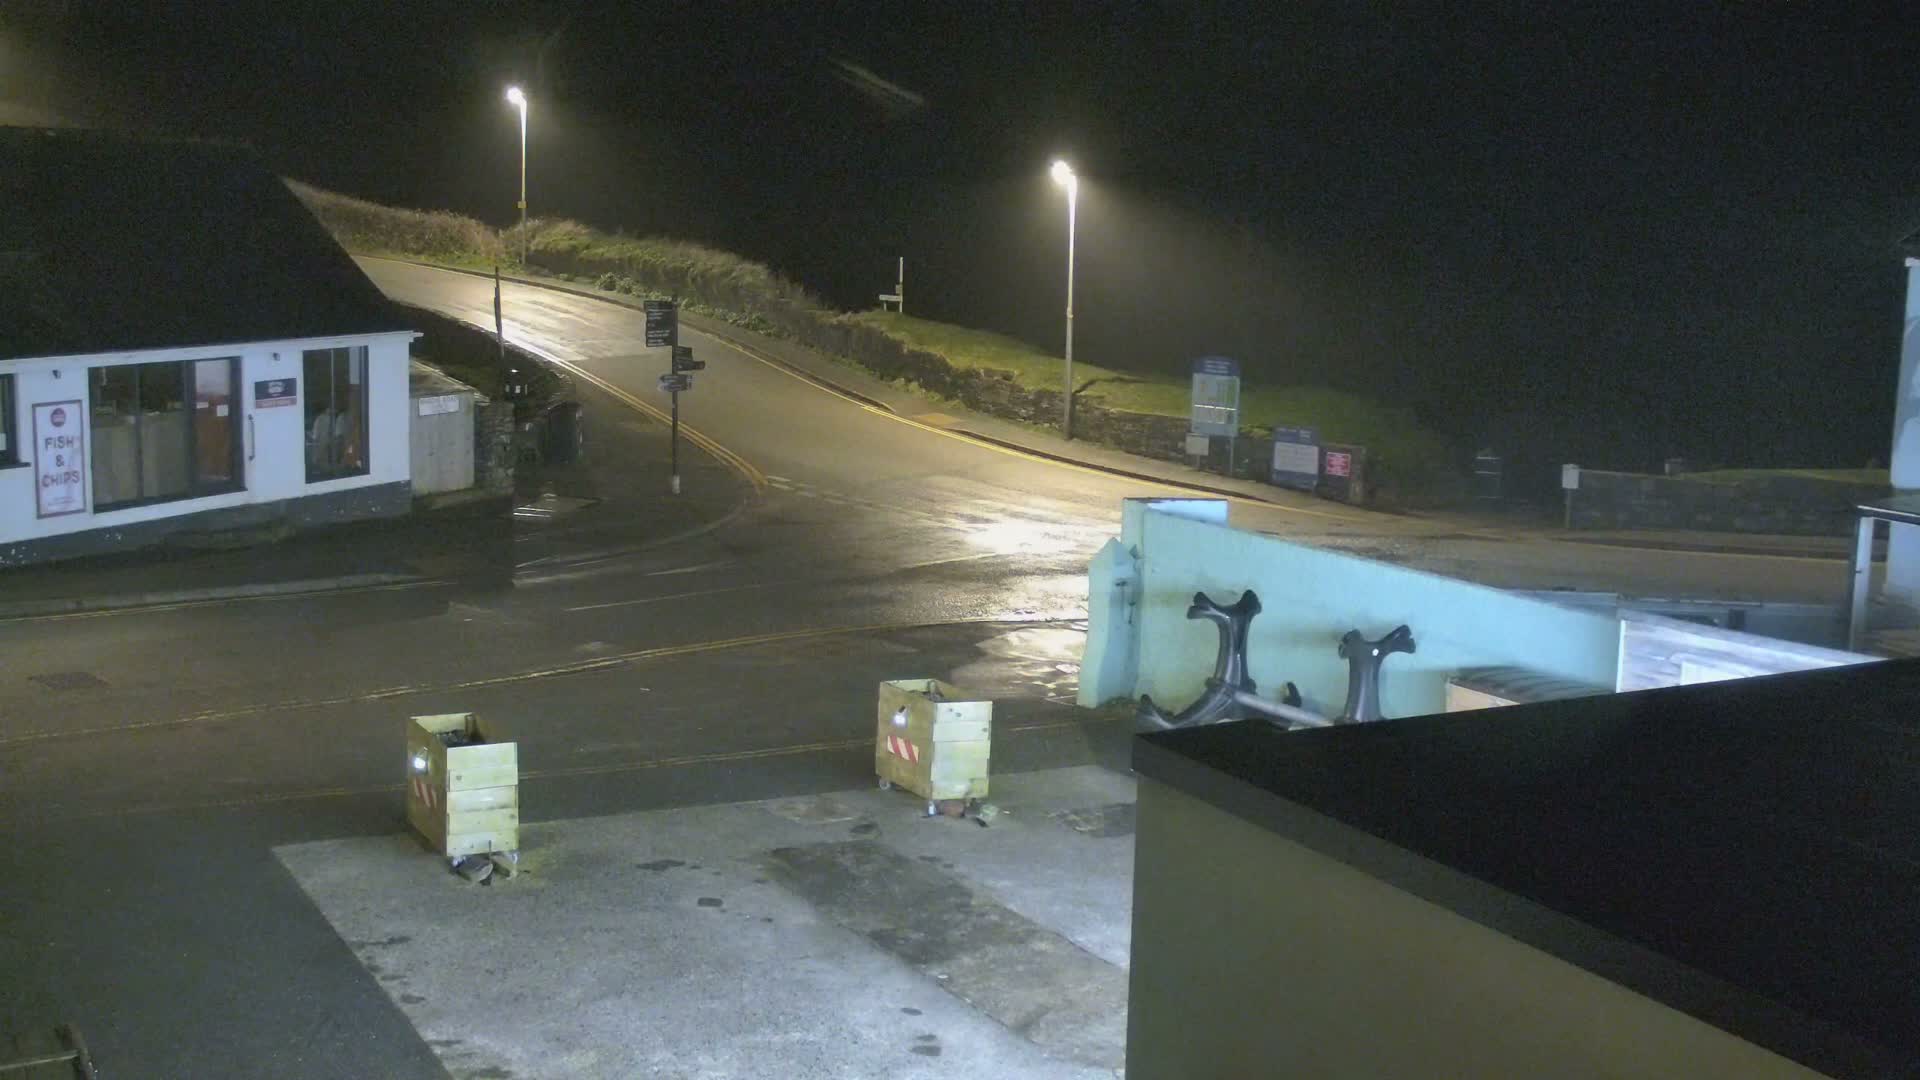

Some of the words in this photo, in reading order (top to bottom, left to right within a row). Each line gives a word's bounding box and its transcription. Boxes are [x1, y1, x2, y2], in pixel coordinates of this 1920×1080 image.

[45, 435, 74, 450] FISH
[55, 454, 65, 467] &
[41, 471, 80, 488] CHIPS
